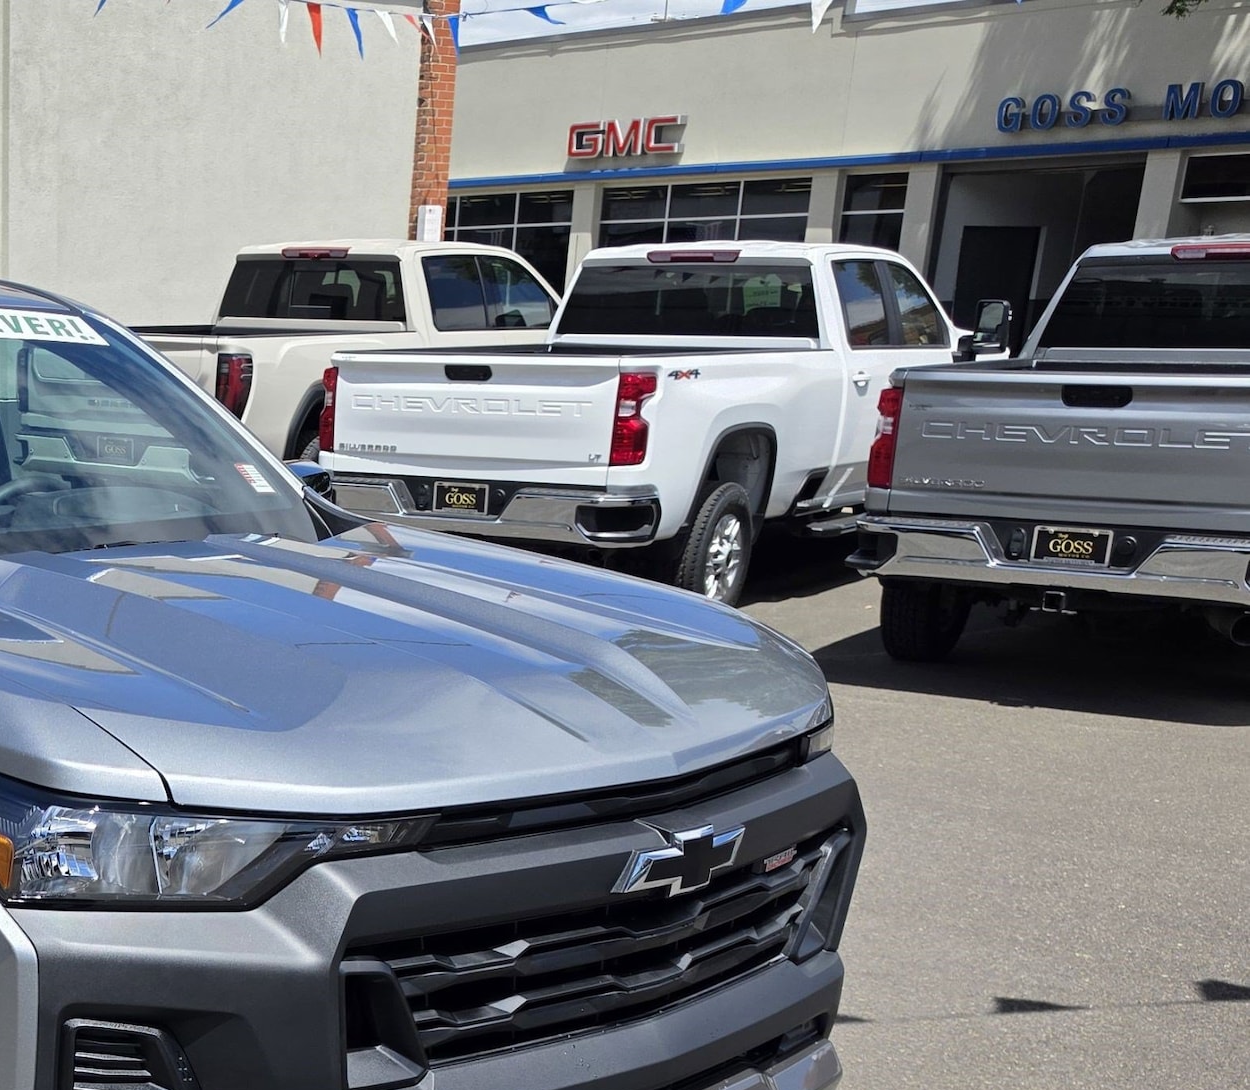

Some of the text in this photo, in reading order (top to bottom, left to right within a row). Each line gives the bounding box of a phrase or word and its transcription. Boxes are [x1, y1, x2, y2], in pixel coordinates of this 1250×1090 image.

[996, 88, 1132, 133] GOSS
[567, 115, 685, 159] GMC
[351, 394, 593, 418] CHEVROLET
[445, 492, 477, 505] GOSS
[1049, 538, 1094, 554] GOSS
